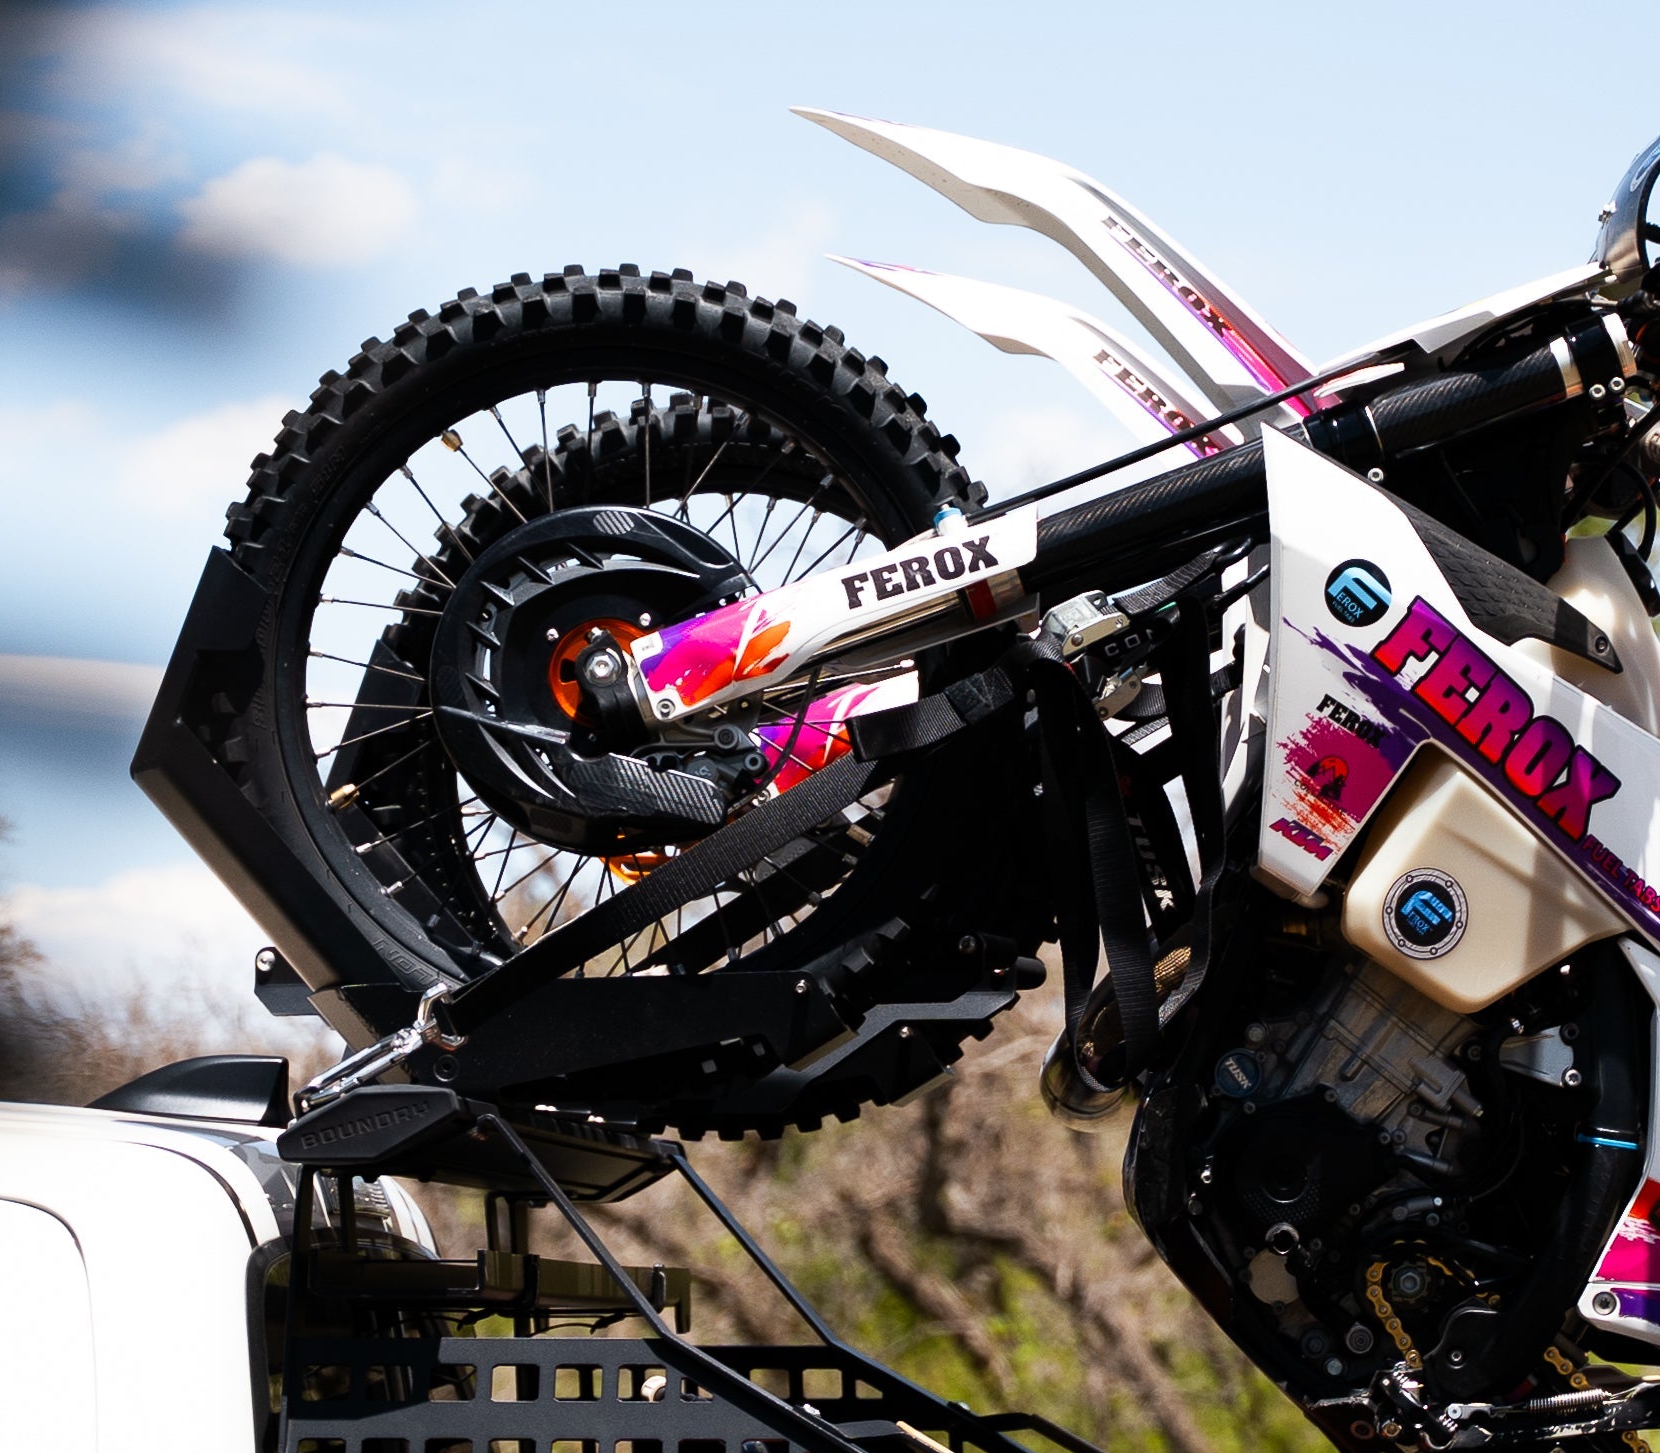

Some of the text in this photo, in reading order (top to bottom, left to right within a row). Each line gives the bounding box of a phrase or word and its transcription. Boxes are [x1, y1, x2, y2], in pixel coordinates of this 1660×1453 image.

[1101, 216, 1233, 338] FEROX
[1093, 349, 1221, 458] FEROX
[841, 535, 1000, 610] FEROX
[1316, 693, 1387, 750] FEROX
[1368, 594, 1622, 843] FEROX
[1269, 817, 1335, 862] KTM
[1582, 833, 1624, 881] FUEL
[1224, 1057, 1253, 1090] TUSK
[300, 1100, 430, 1150] BOUNDRY
